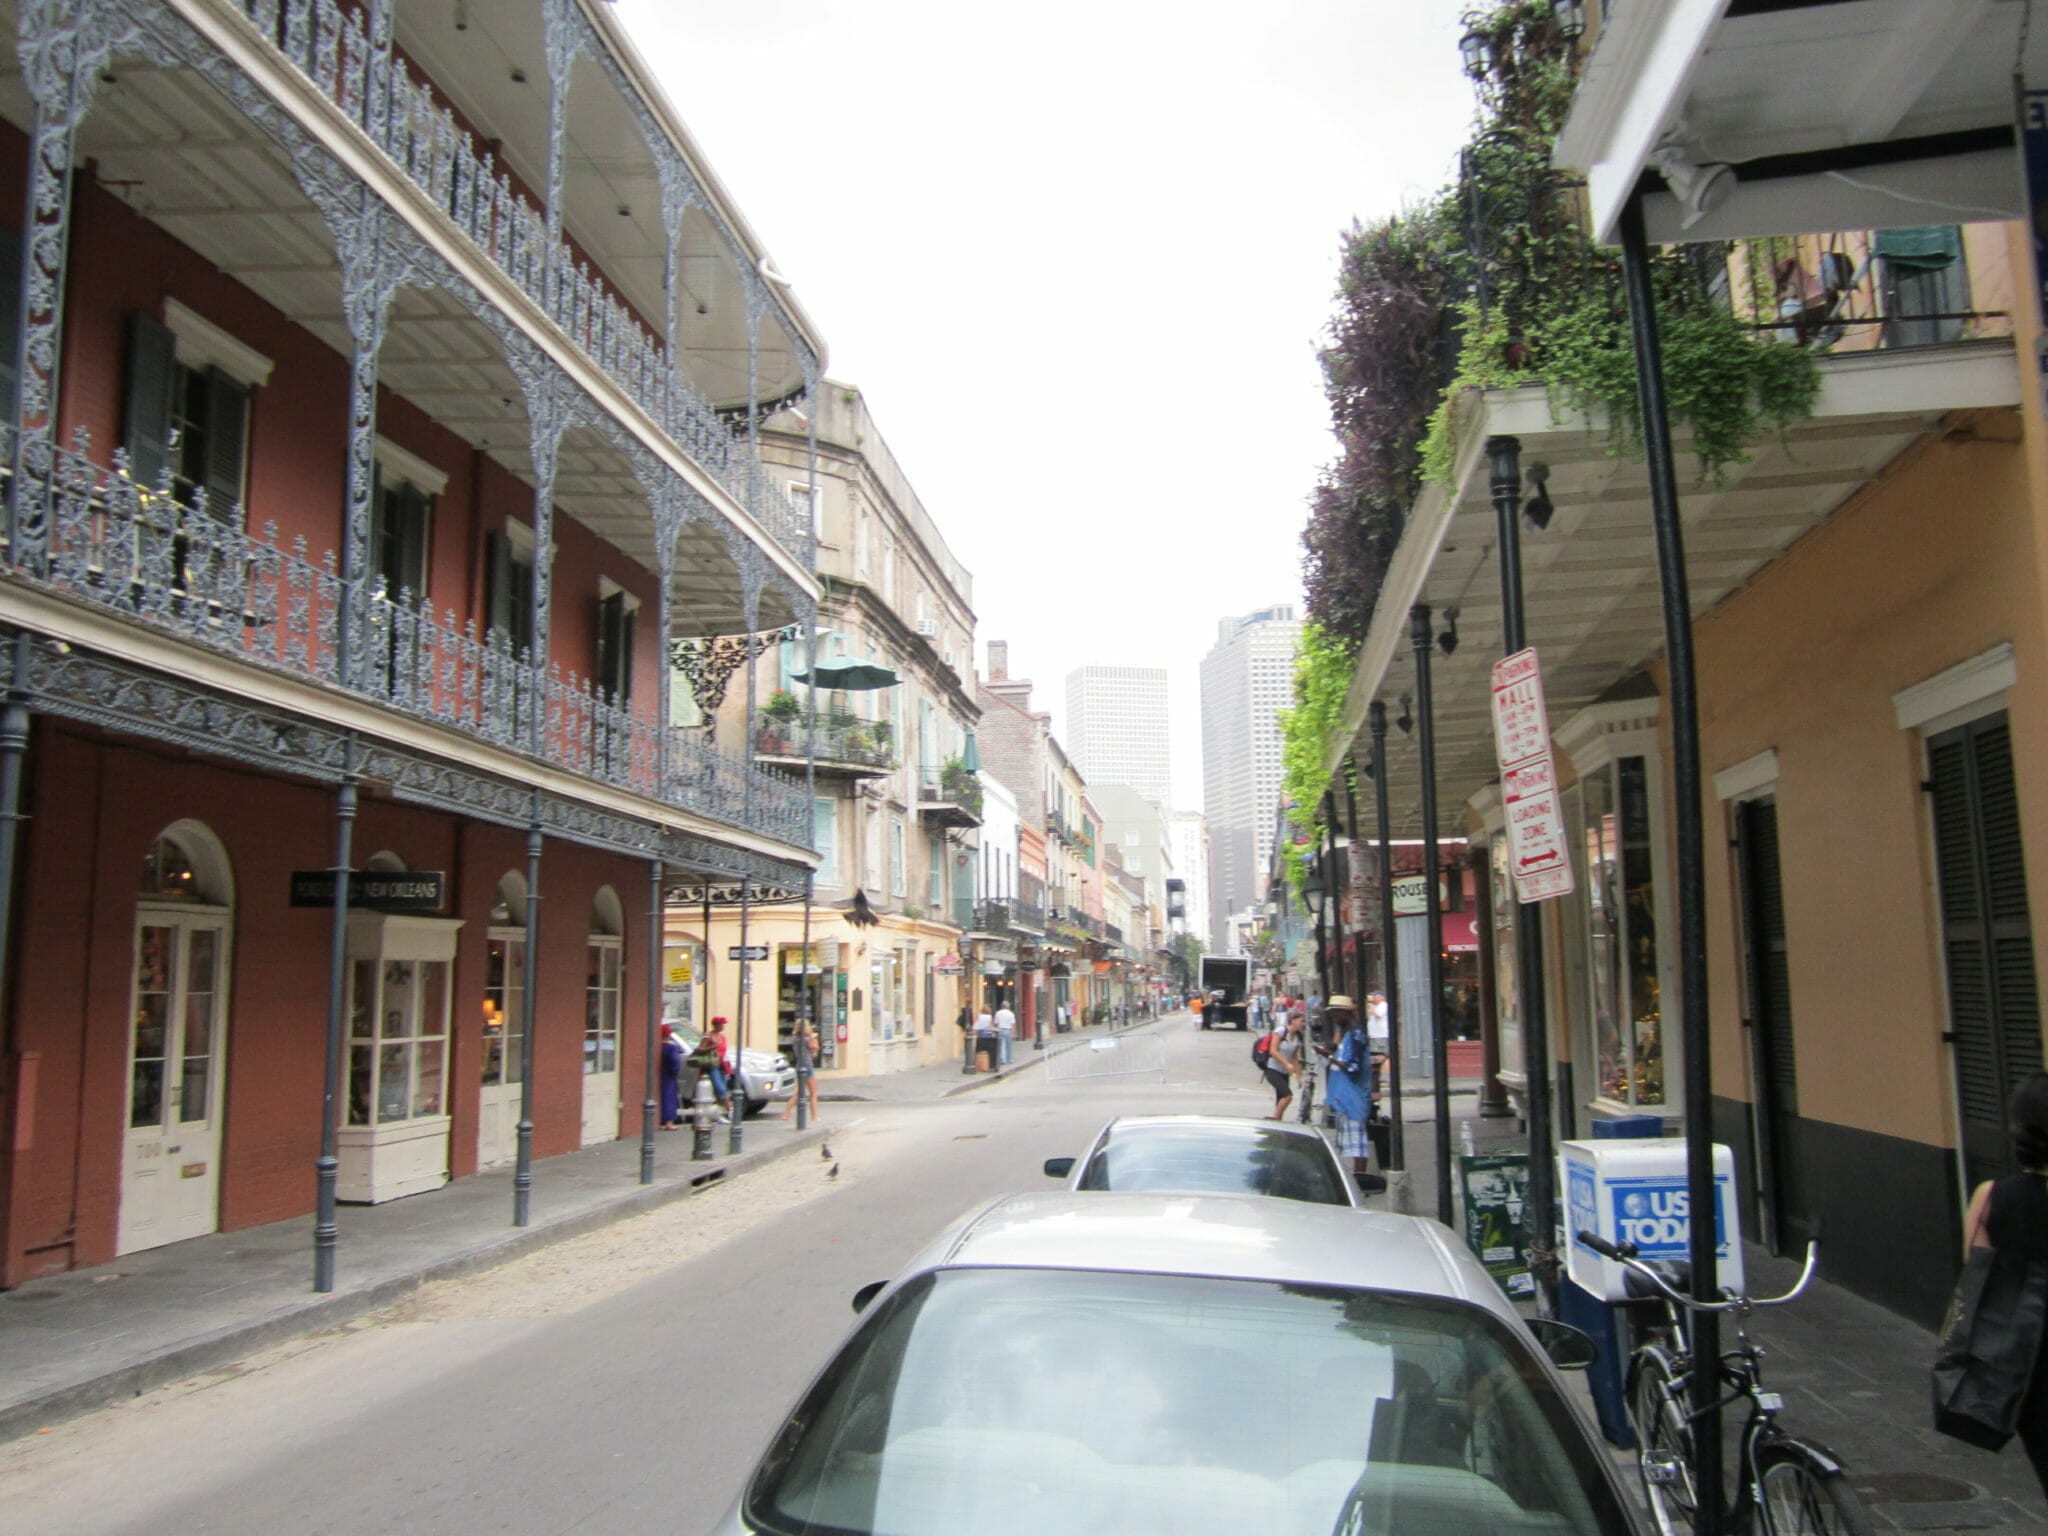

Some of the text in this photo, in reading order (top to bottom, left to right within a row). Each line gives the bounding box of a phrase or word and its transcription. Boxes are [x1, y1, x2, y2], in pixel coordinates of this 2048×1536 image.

[1499, 683, 1534, 712] MALL
[1513, 799, 1552, 824] LOADING
[1522, 822, 1547, 841] ZONE
[389, 882, 437, 899] ORLEANS
[1391, 882, 1427, 898] ROUSE
[1650, 1190, 1690, 1217] US
[1620, 1217, 1690, 1245] TOD
